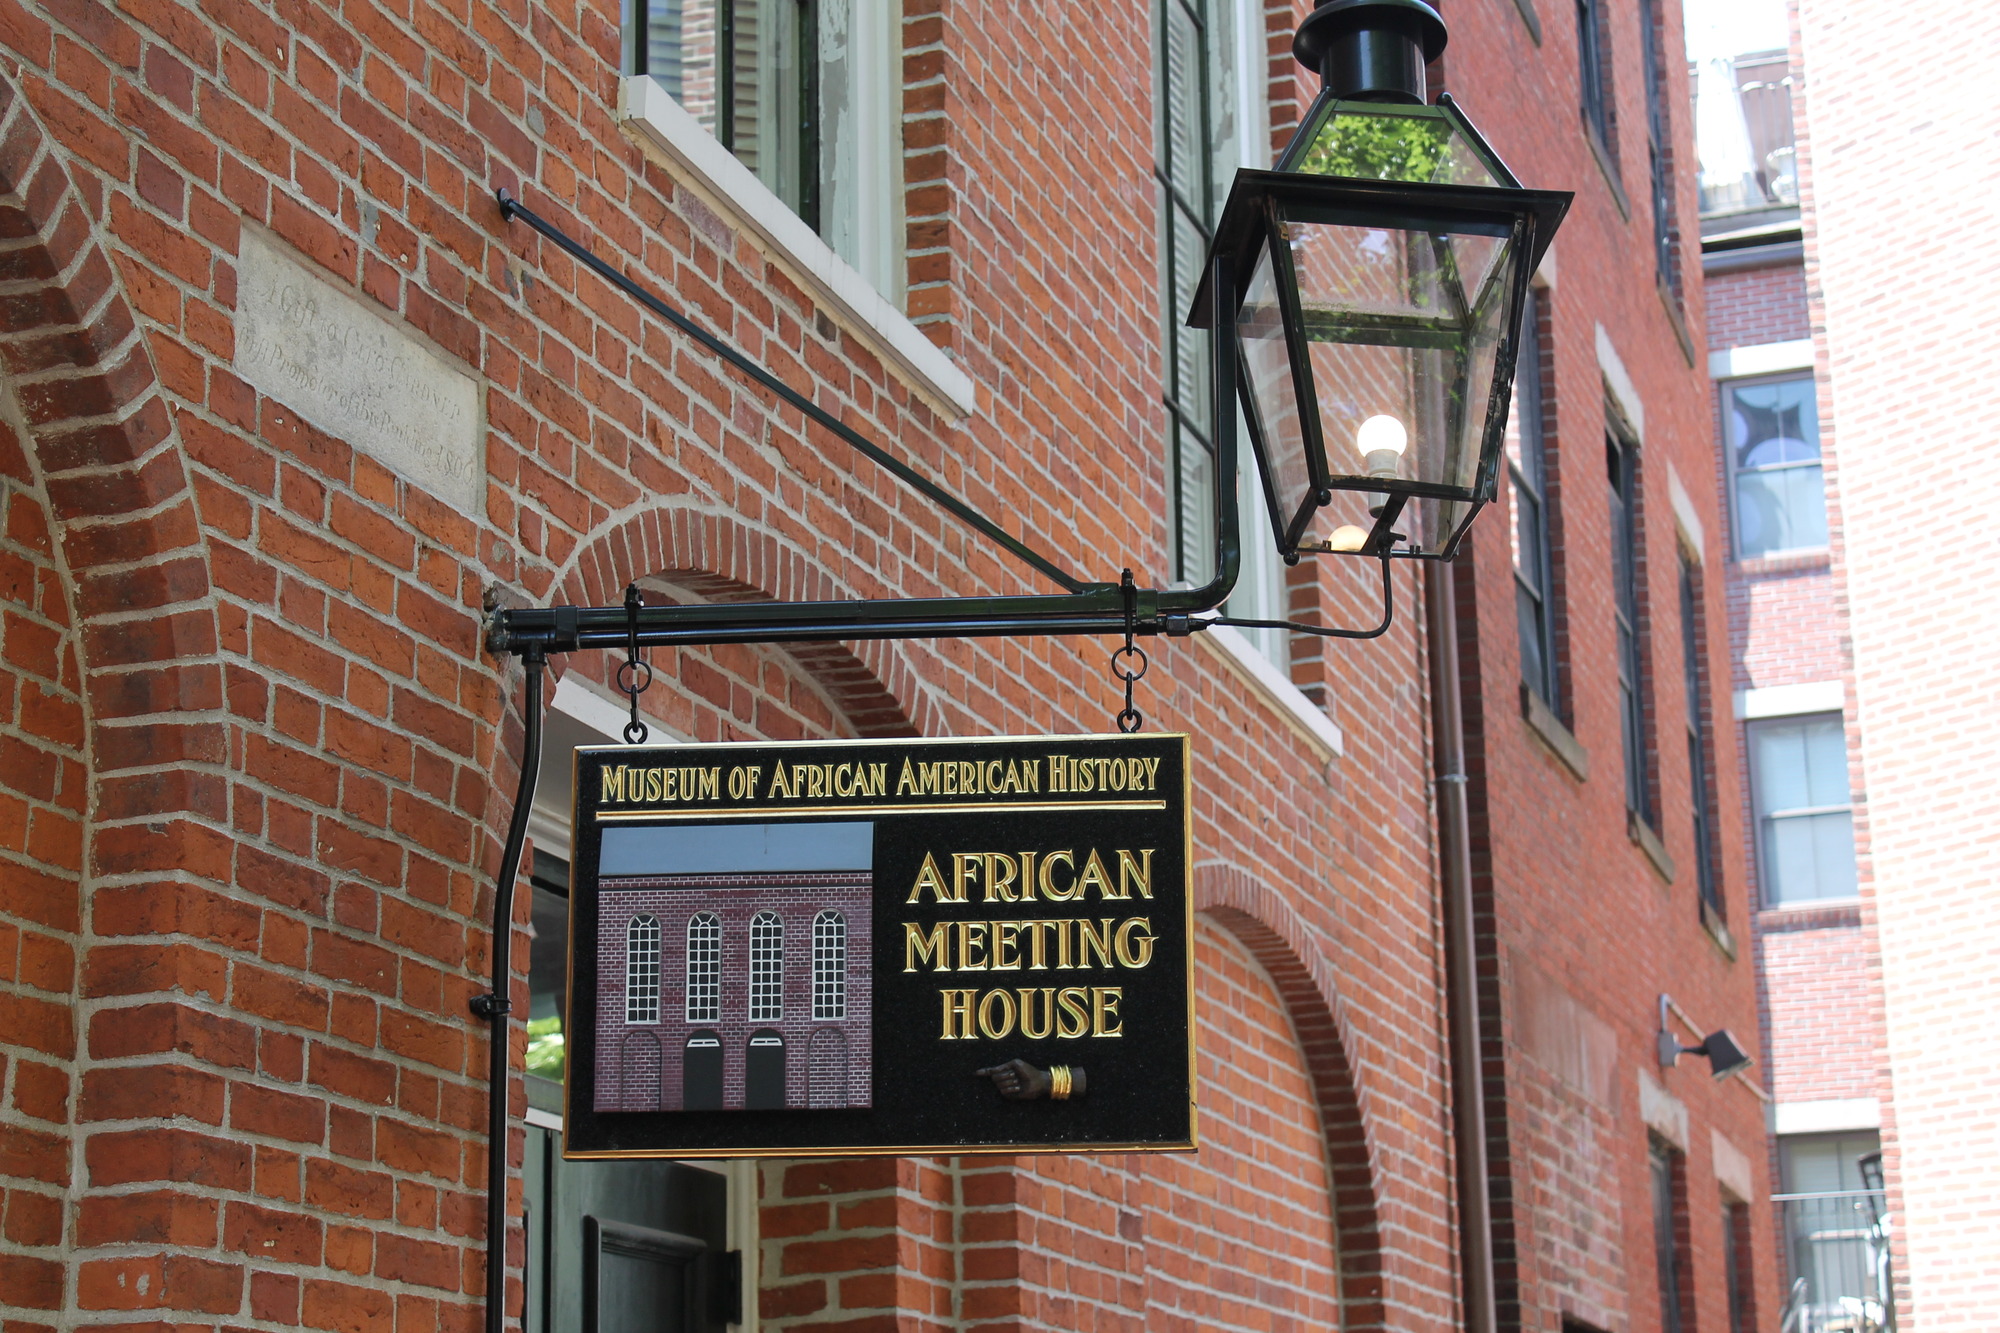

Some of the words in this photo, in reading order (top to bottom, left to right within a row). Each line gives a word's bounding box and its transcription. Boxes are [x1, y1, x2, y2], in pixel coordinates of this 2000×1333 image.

[281, 285, 318, 328] Gift
[602, 765, 720, 801] MUSEUM
[728, 766, 761, 799] OF
[769, 760, 886, 798] AFRICAN
[897, 758, 1040, 795] AMERICAN
[1048, 755, 1160, 792] HISTORY
[906, 849, 1155, 904] AFRICAN
[902, 917, 1157, 972] MEETING
[939, 987, 1122, 1040] HOUSE
